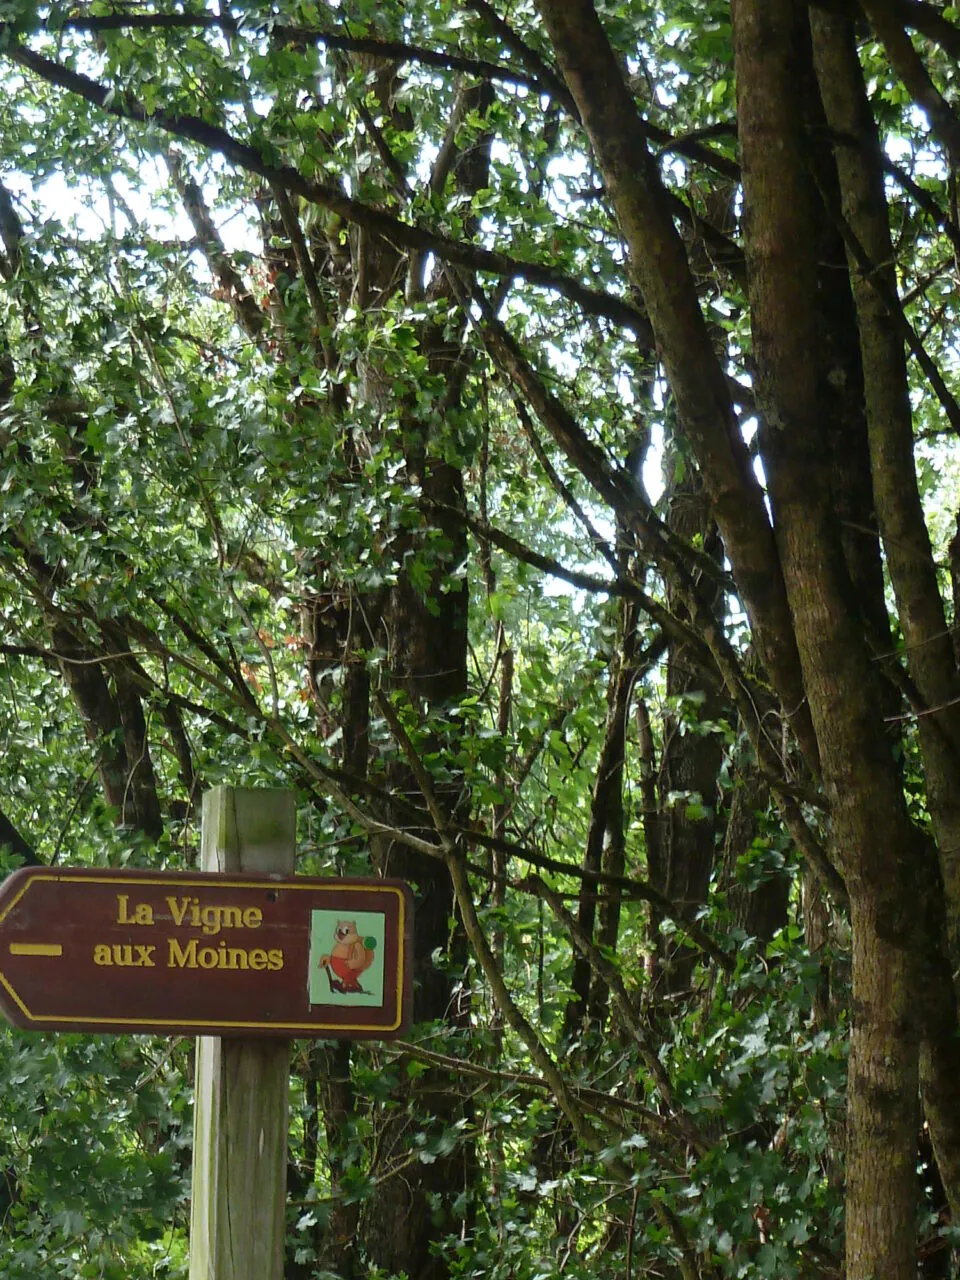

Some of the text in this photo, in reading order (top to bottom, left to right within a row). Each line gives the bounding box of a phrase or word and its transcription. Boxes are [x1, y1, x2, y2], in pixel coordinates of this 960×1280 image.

[117, 894, 263, 935] La Vigne
[93, 939, 285, 971] aux Moines
